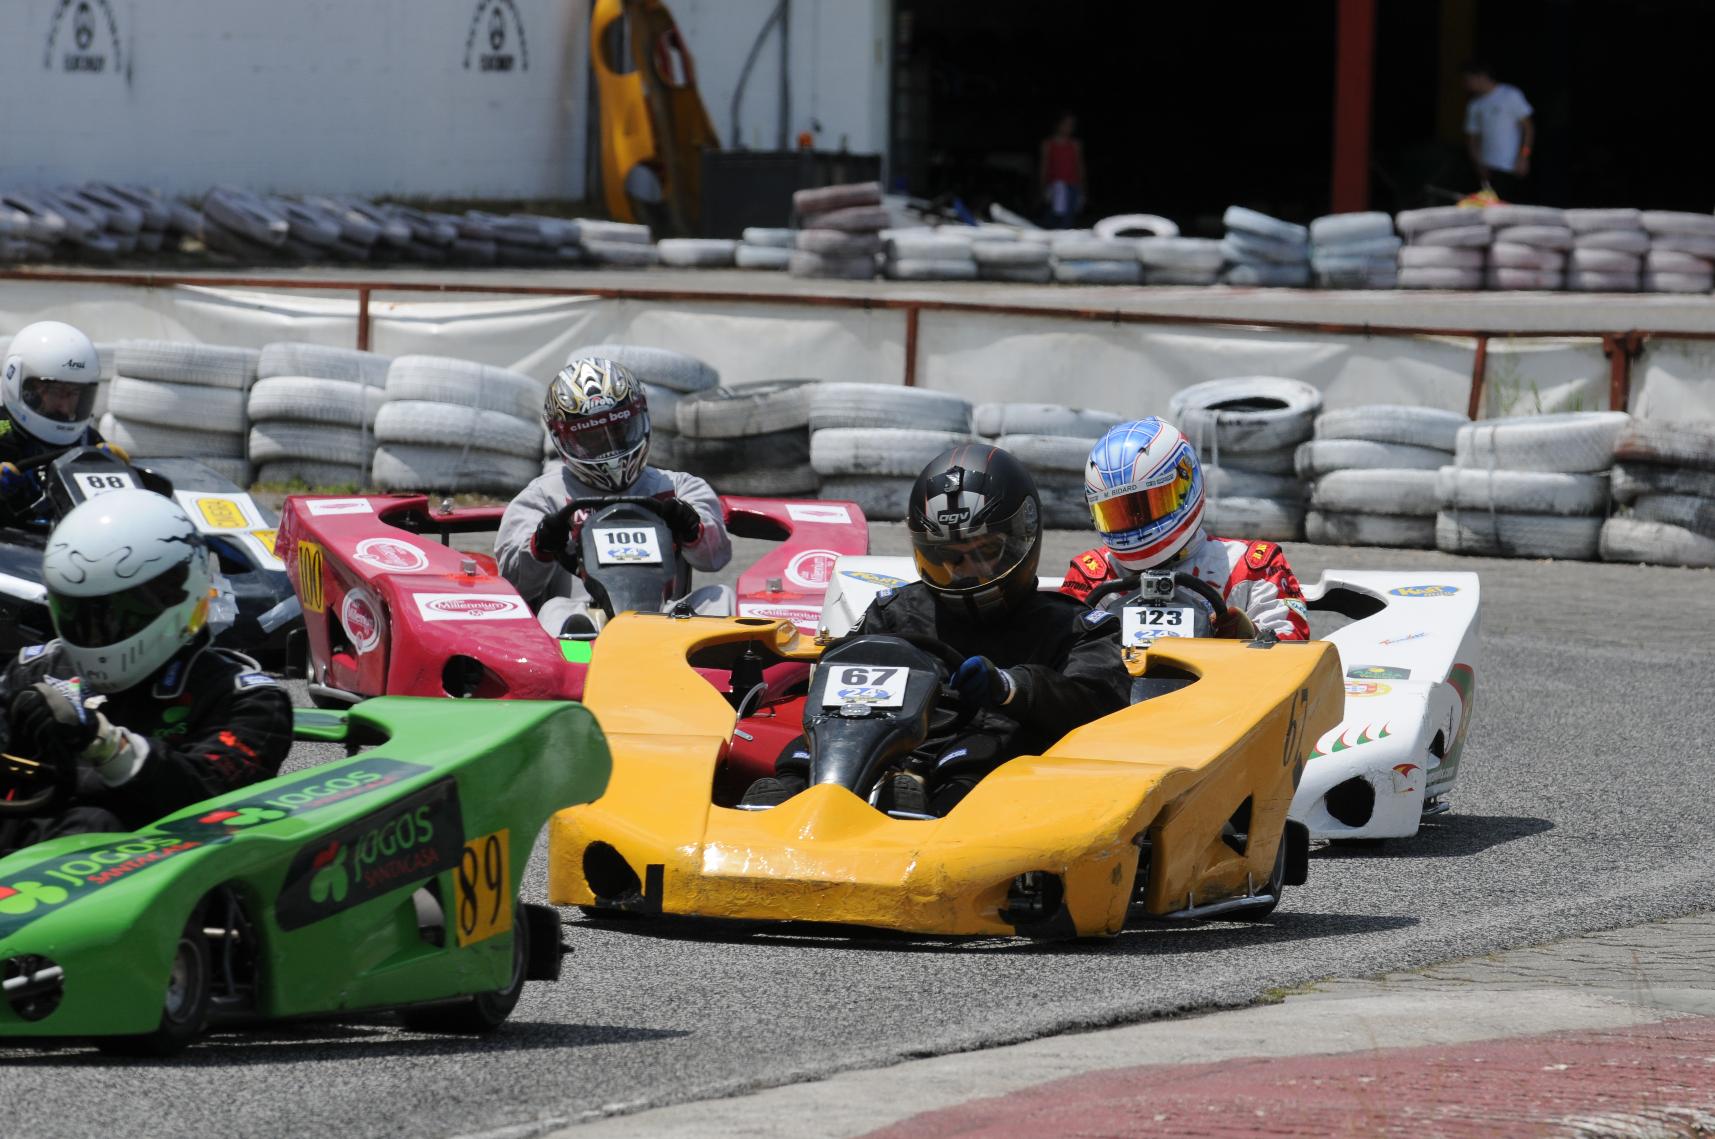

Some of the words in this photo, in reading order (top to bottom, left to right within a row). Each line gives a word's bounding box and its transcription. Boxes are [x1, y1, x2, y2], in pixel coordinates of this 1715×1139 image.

[62, 359, 85, 369] Arai
[570, 418, 607, 432] clube
[609, 410, 630, 421] bcp
[86, 475, 125, 488] 88
[938, 511, 970, 524] agv
[605, 531, 647, 544] 100
[1136, 610, 1182, 625] 123
[841, 668, 898, 686] 67
[1283, 688, 1308, 768] 67
[264, 771, 382, 809] JOGOS
[354, 805, 433, 882] JOGOS
[45, 838, 182, 886] JOGOS
[460, 835, 502, 935] 89
